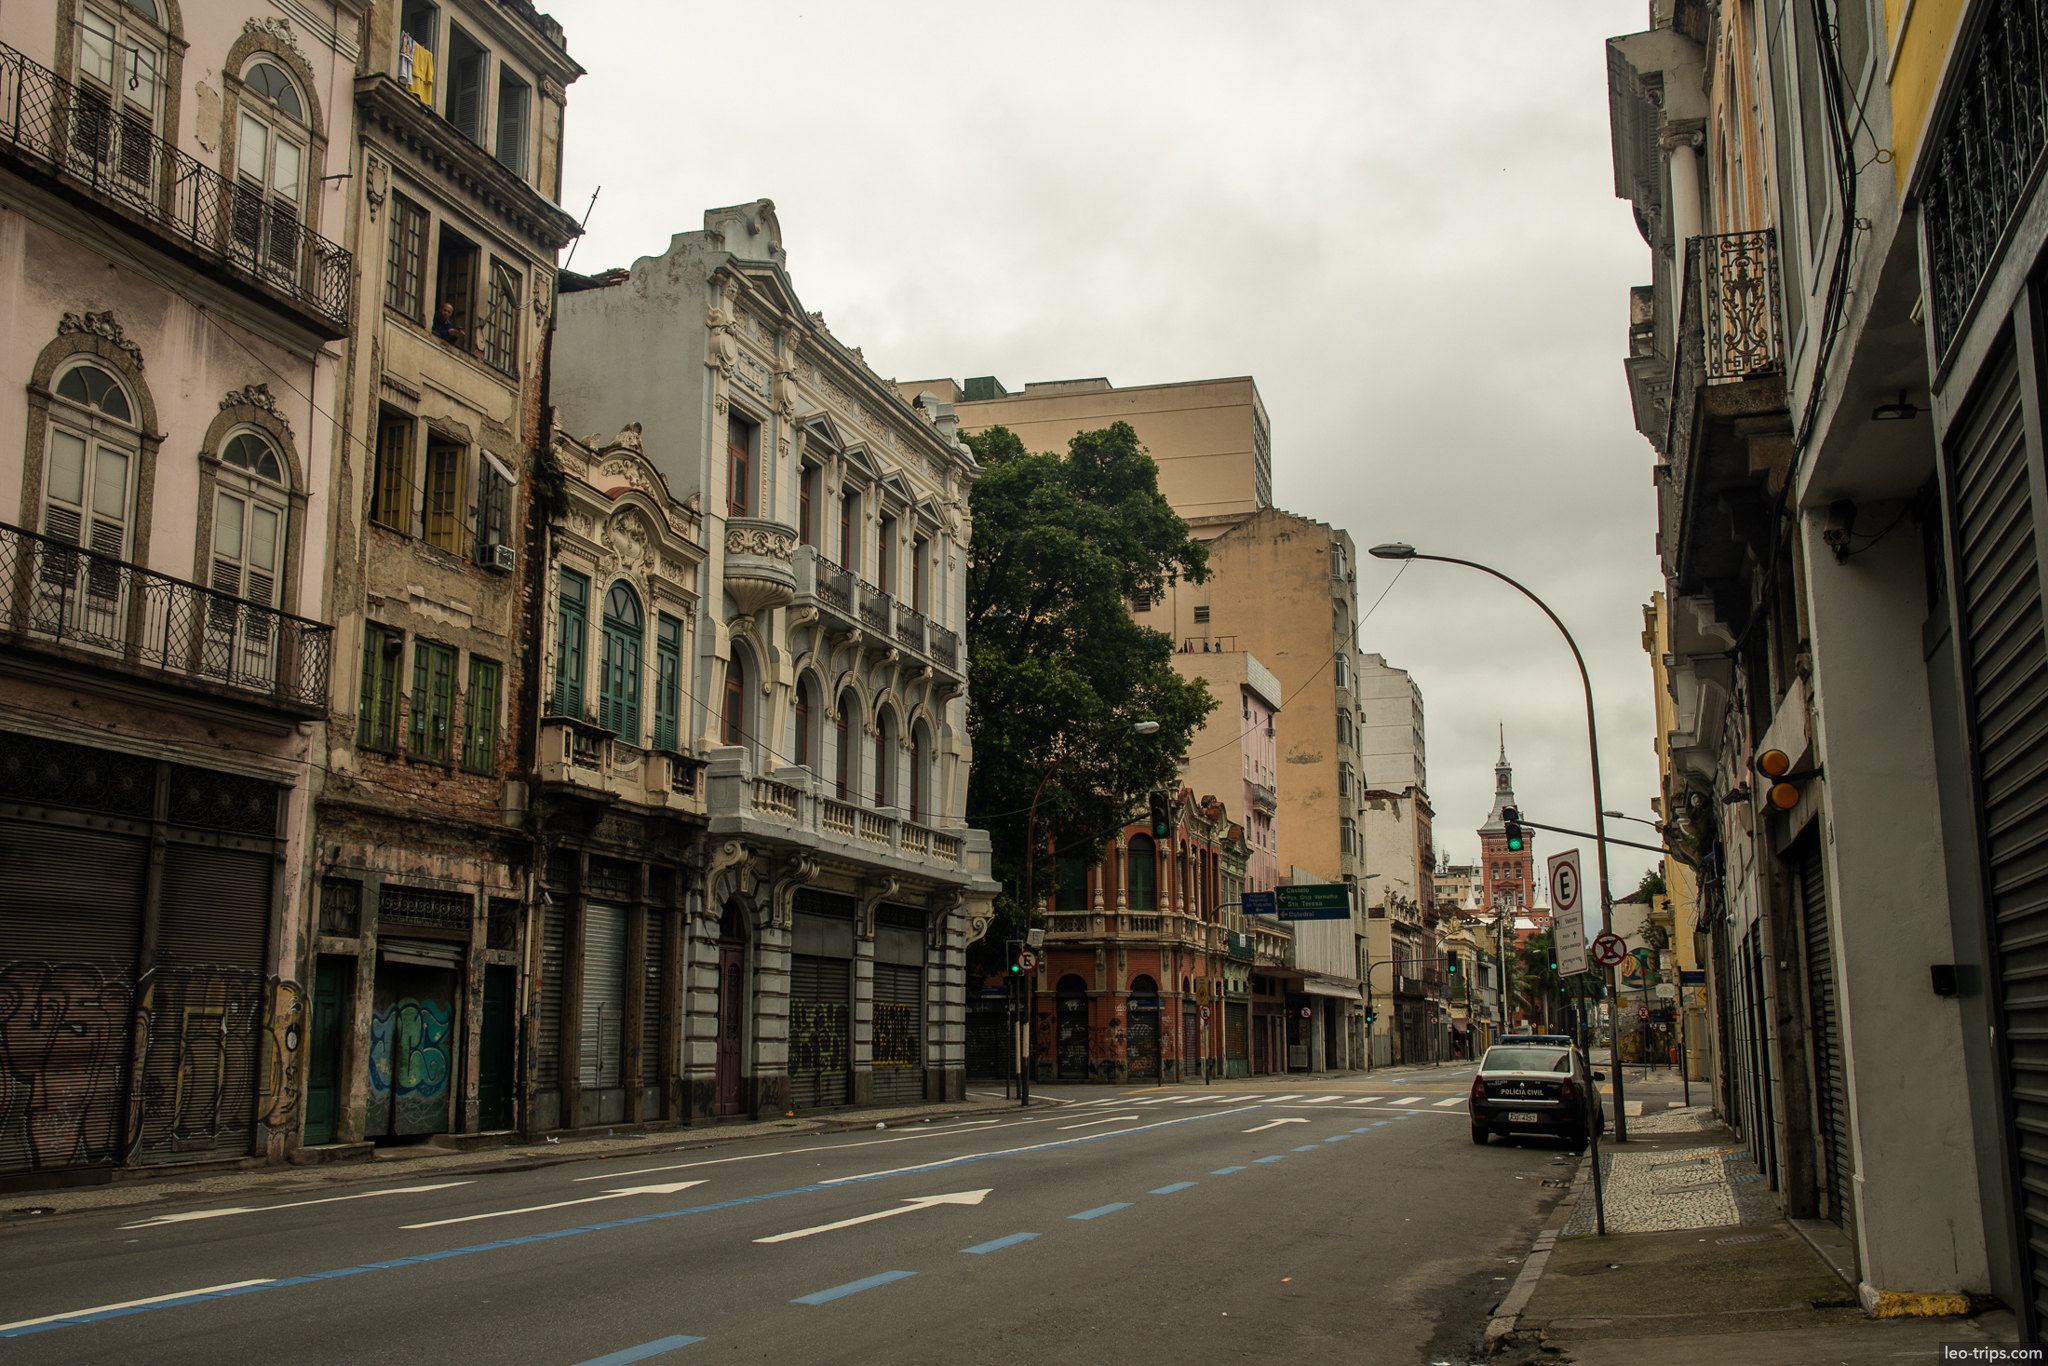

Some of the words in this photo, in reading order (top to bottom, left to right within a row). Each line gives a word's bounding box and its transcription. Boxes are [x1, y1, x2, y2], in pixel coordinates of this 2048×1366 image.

[1559, 871, 1570, 900] E
[1564, 916, 1578, 925] Valores
[1023, 954, 1032, 967] E
[1501, 1087, 1526, 1095] POLÍCIA
